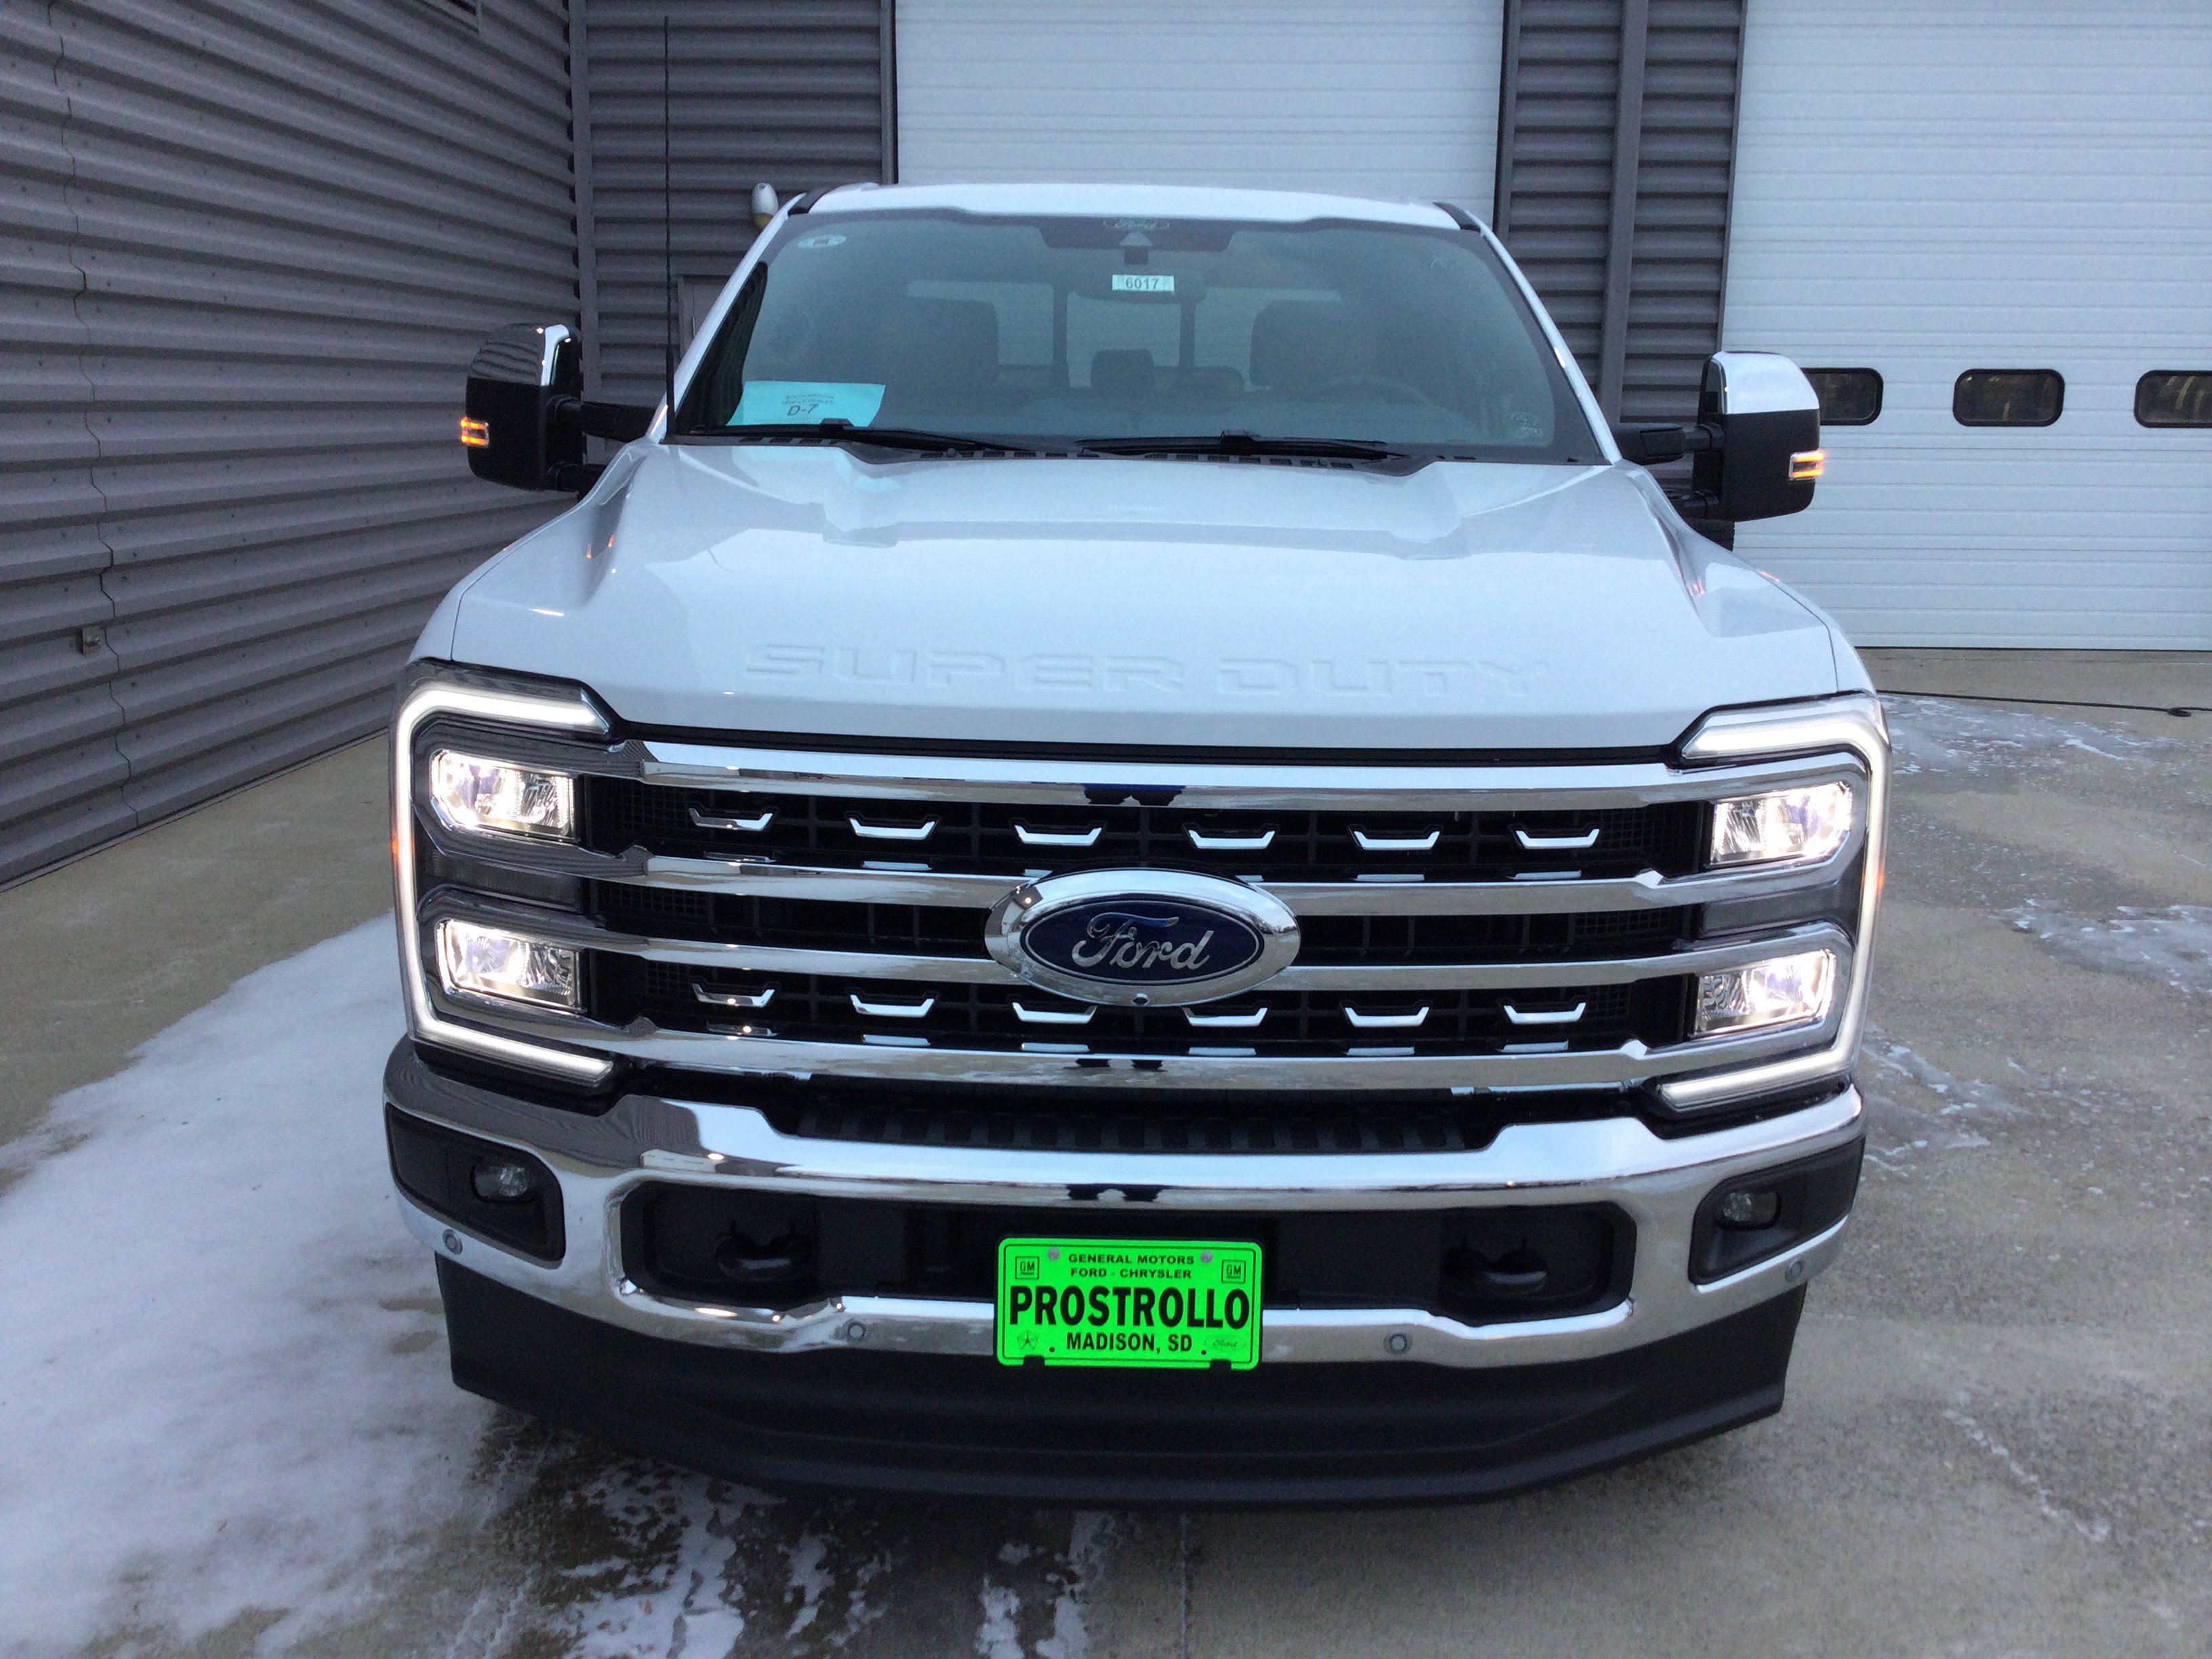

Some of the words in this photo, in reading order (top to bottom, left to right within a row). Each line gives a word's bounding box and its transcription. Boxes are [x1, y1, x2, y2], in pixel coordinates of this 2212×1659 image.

[1125, 277, 1159, 289] 6017
[787, 403, 819, 416] D-7
[745, 643, 1184, 693] SUPER
[1217, 657, 1550, 697] DUTY
[1071, 912, 1214, 970] Ford
[1068, 1253, 1132, 1264] GENERAL
[1137, 1254, 1195, 1265] MOTORS
[1019, 1261, 1036, 1272] GM
[1226, 1264, 1242, 1275] GM
[1070, 1267, 1107, 1277] FORD
[1120, 1268, 1192, 1279] CHRYSLER
[1009, 1285, 1250, 1330] PROSTROLLO
[1066, 1332, 1161, 1354] MADISON,
[1168, 1334, 1193, 1352] SD
